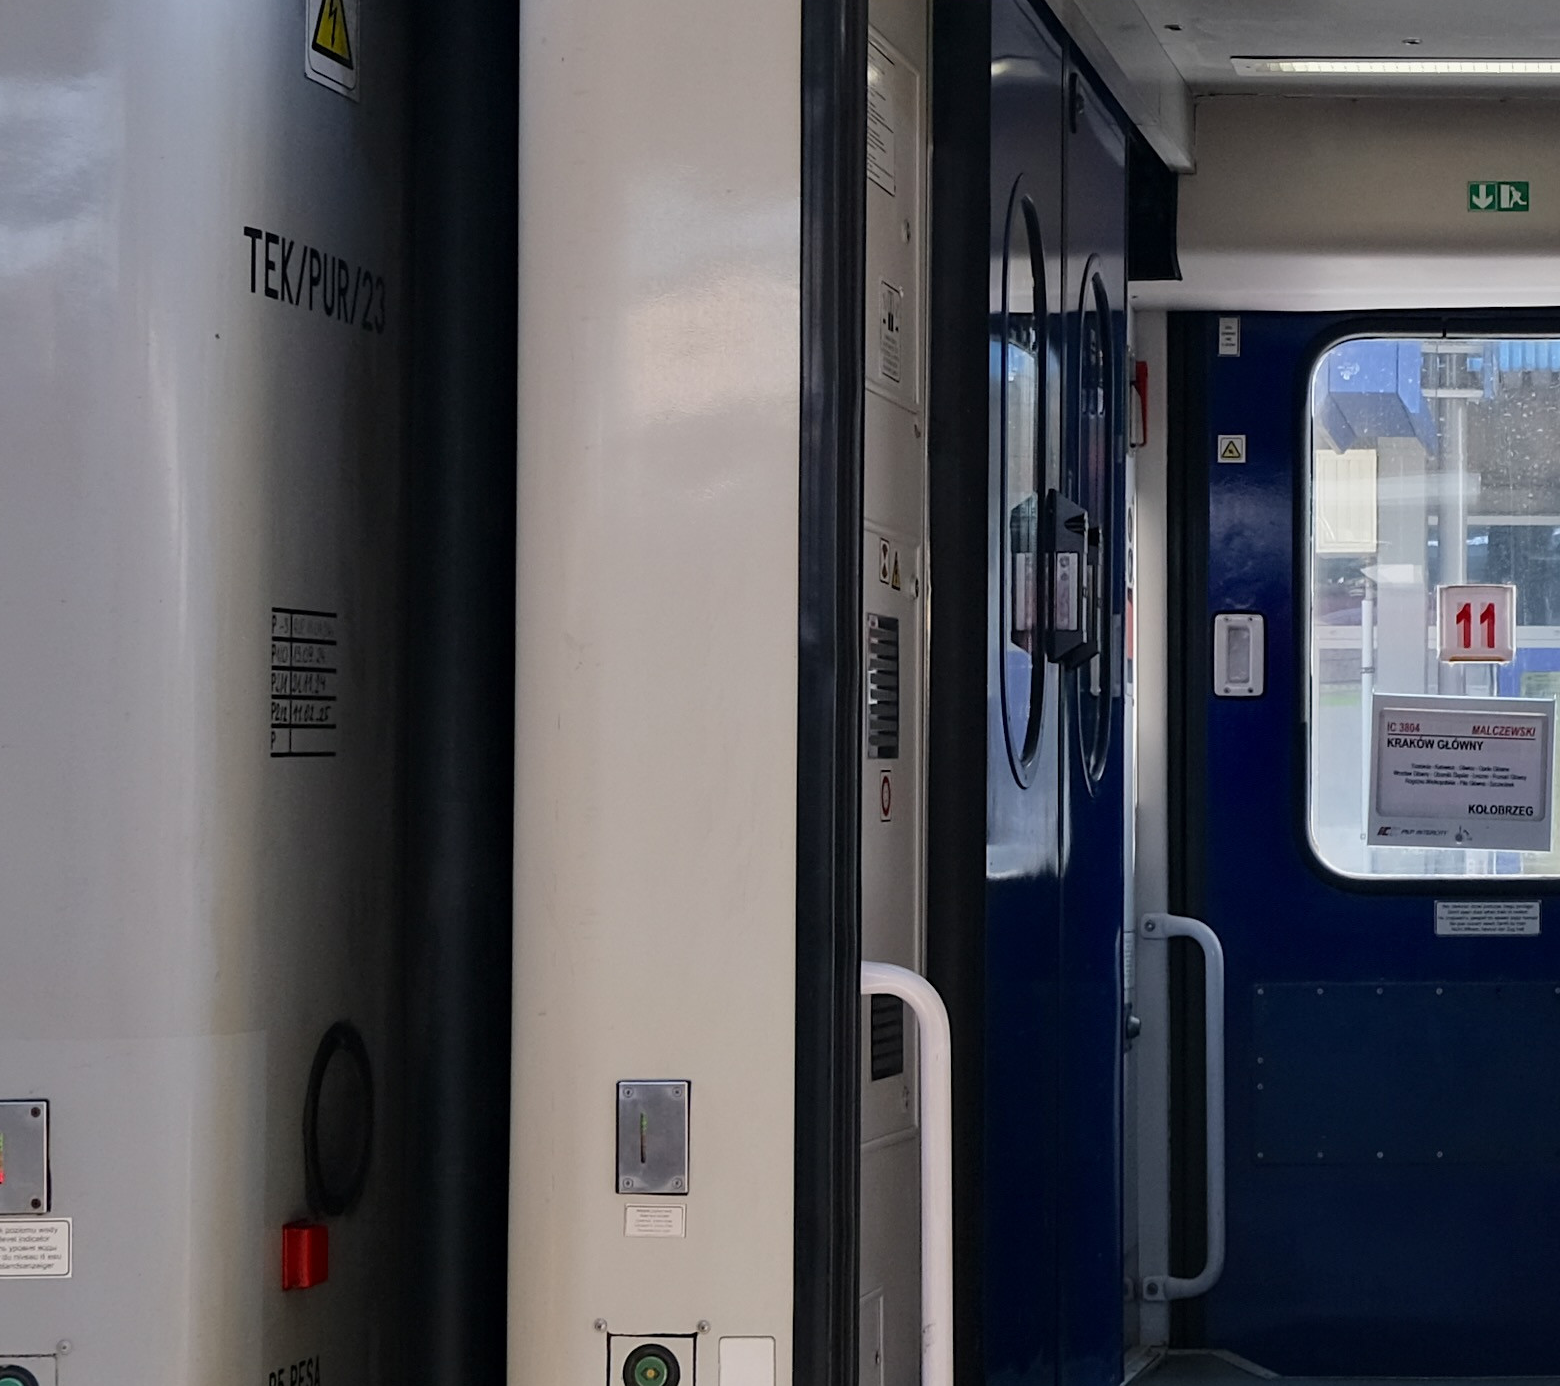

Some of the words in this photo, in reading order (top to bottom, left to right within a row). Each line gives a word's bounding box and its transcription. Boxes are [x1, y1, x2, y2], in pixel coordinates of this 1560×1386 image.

[243, 226, 386, 335] TEK/PUR/23
[1456, 603, 1495, 649] 11
[1387, 722, 1397, 732] IC
[1399, 722, 1420, 733] 3804
[1471, 725, 1536, 737] MALCZEWSKI
[1387, 735, 1435, 750] KRAKÓW
[1437, 736, 1484, 751] GŁÓWNY
[1468, 804, 1534, 817] KOŁOBRZEG
